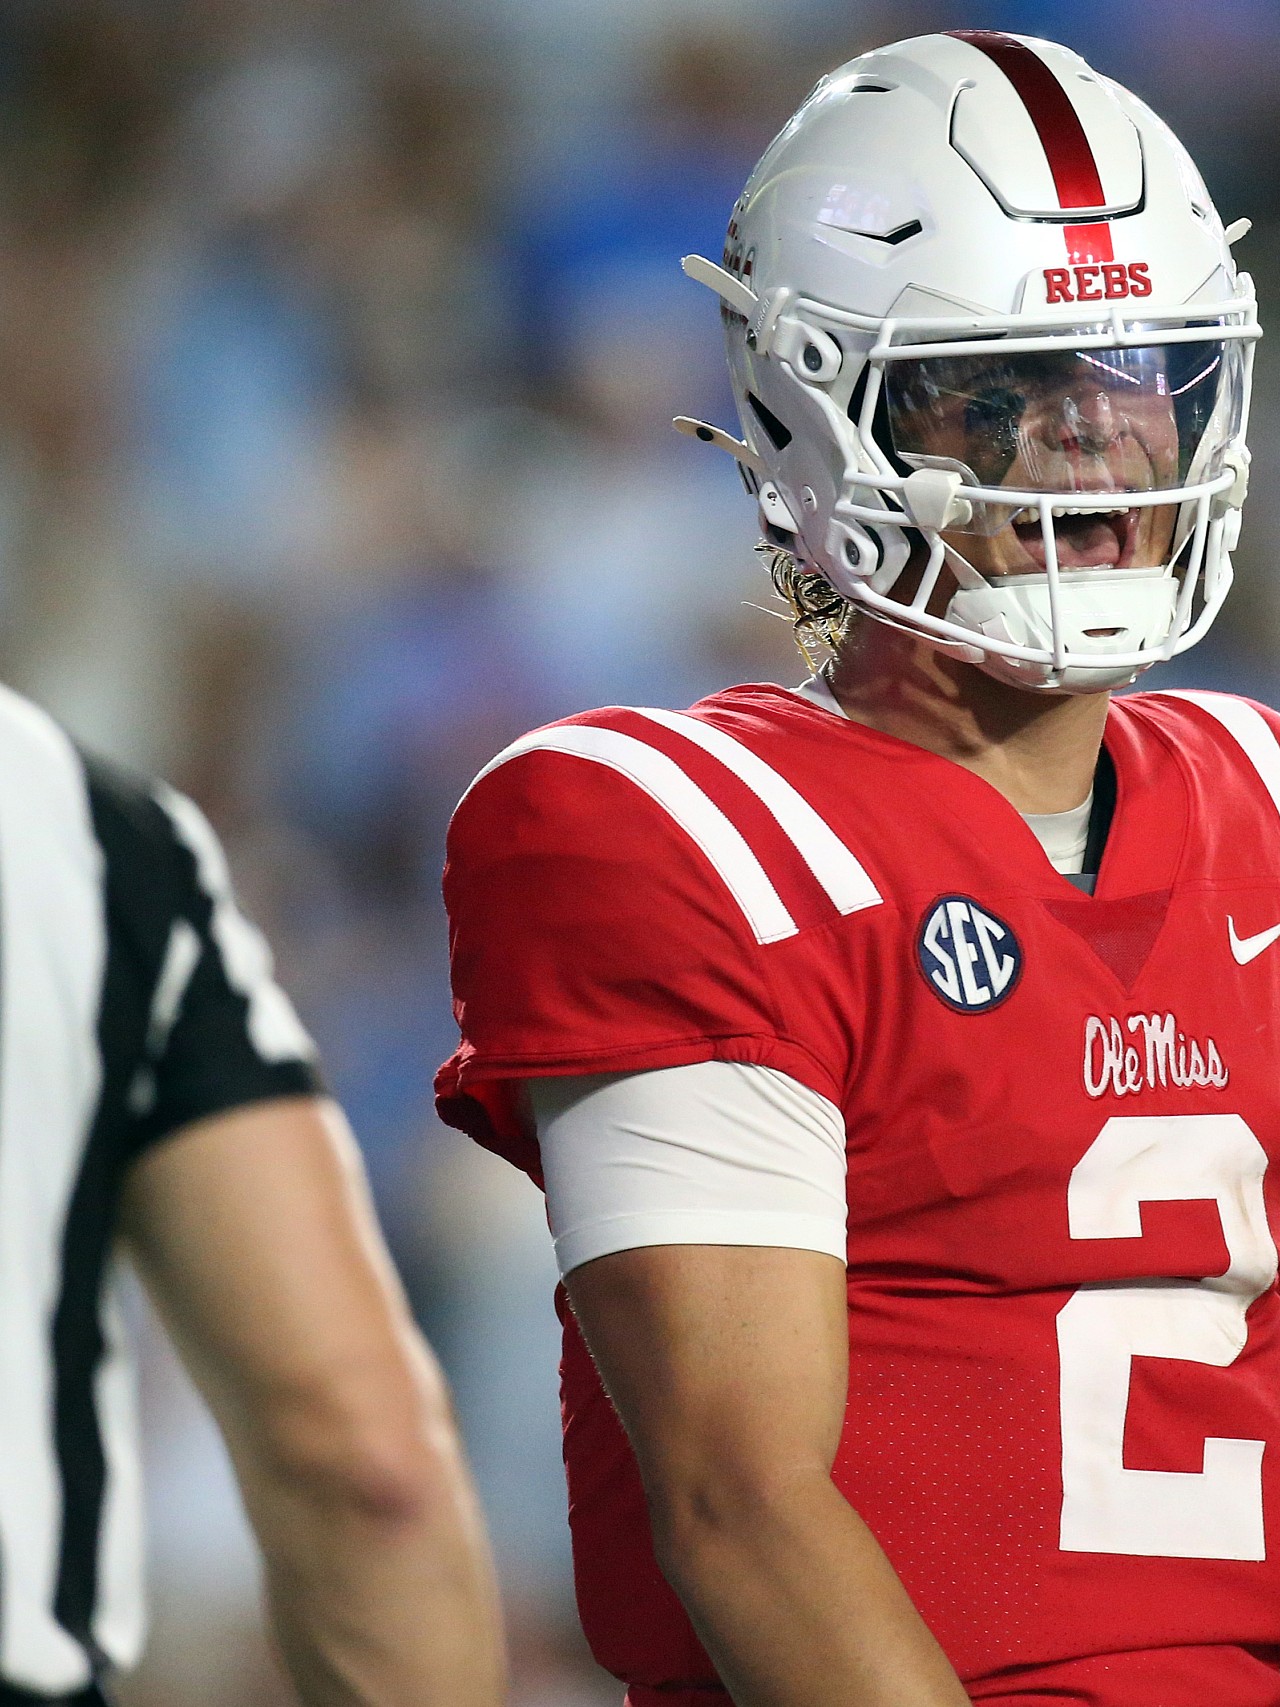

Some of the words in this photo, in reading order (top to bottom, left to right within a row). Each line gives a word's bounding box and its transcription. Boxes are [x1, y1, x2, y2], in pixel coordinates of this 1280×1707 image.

[1043, 262, 1153, 304] REBS
[923, 901, 1015, 1006] SEC
[1083, 1014, 1143, 1098] Ole
[1127, 1012, 1230, 1090] Miss
[1055, 1113, 1278, 1562] 2
